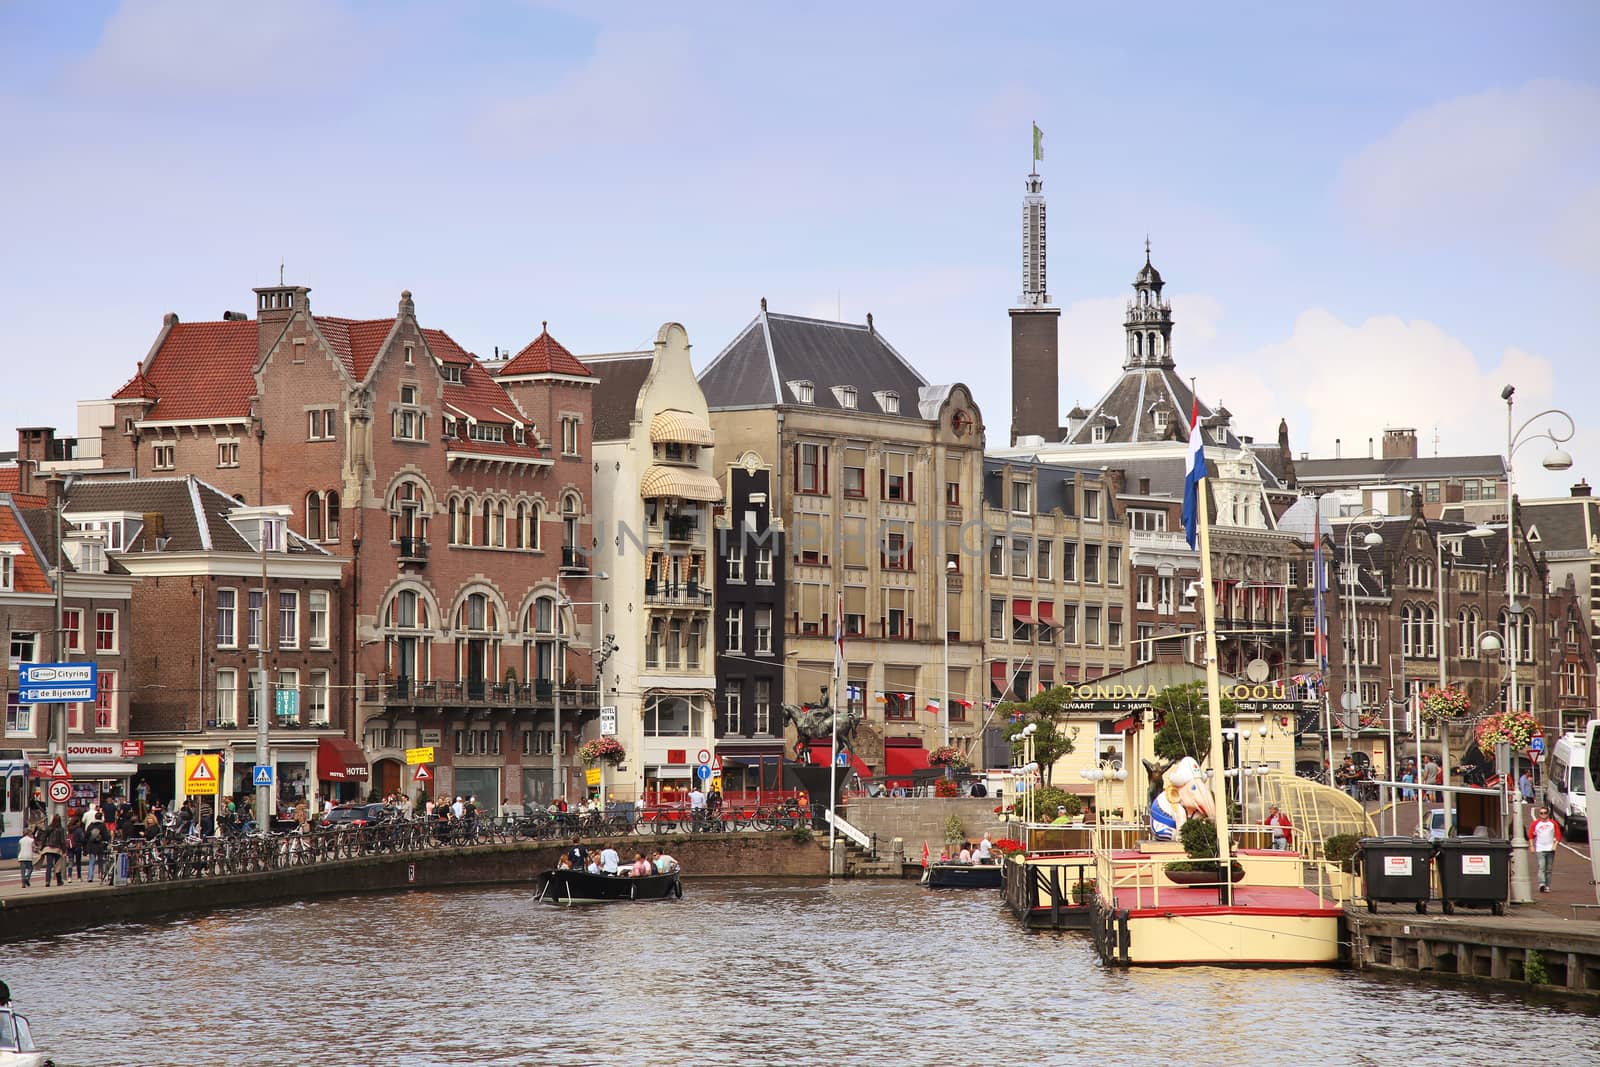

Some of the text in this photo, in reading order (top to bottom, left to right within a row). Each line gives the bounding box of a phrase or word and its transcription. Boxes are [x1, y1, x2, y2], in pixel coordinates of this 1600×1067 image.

[57, 671, 89, 680] Cityring
[52, 689, 88, 698] Bijenkorf
[68, 746, 112, 754] SOUVENIRS
[345, 767, 368, 775] HOTEL
[53, 786, 67, 796] 30
